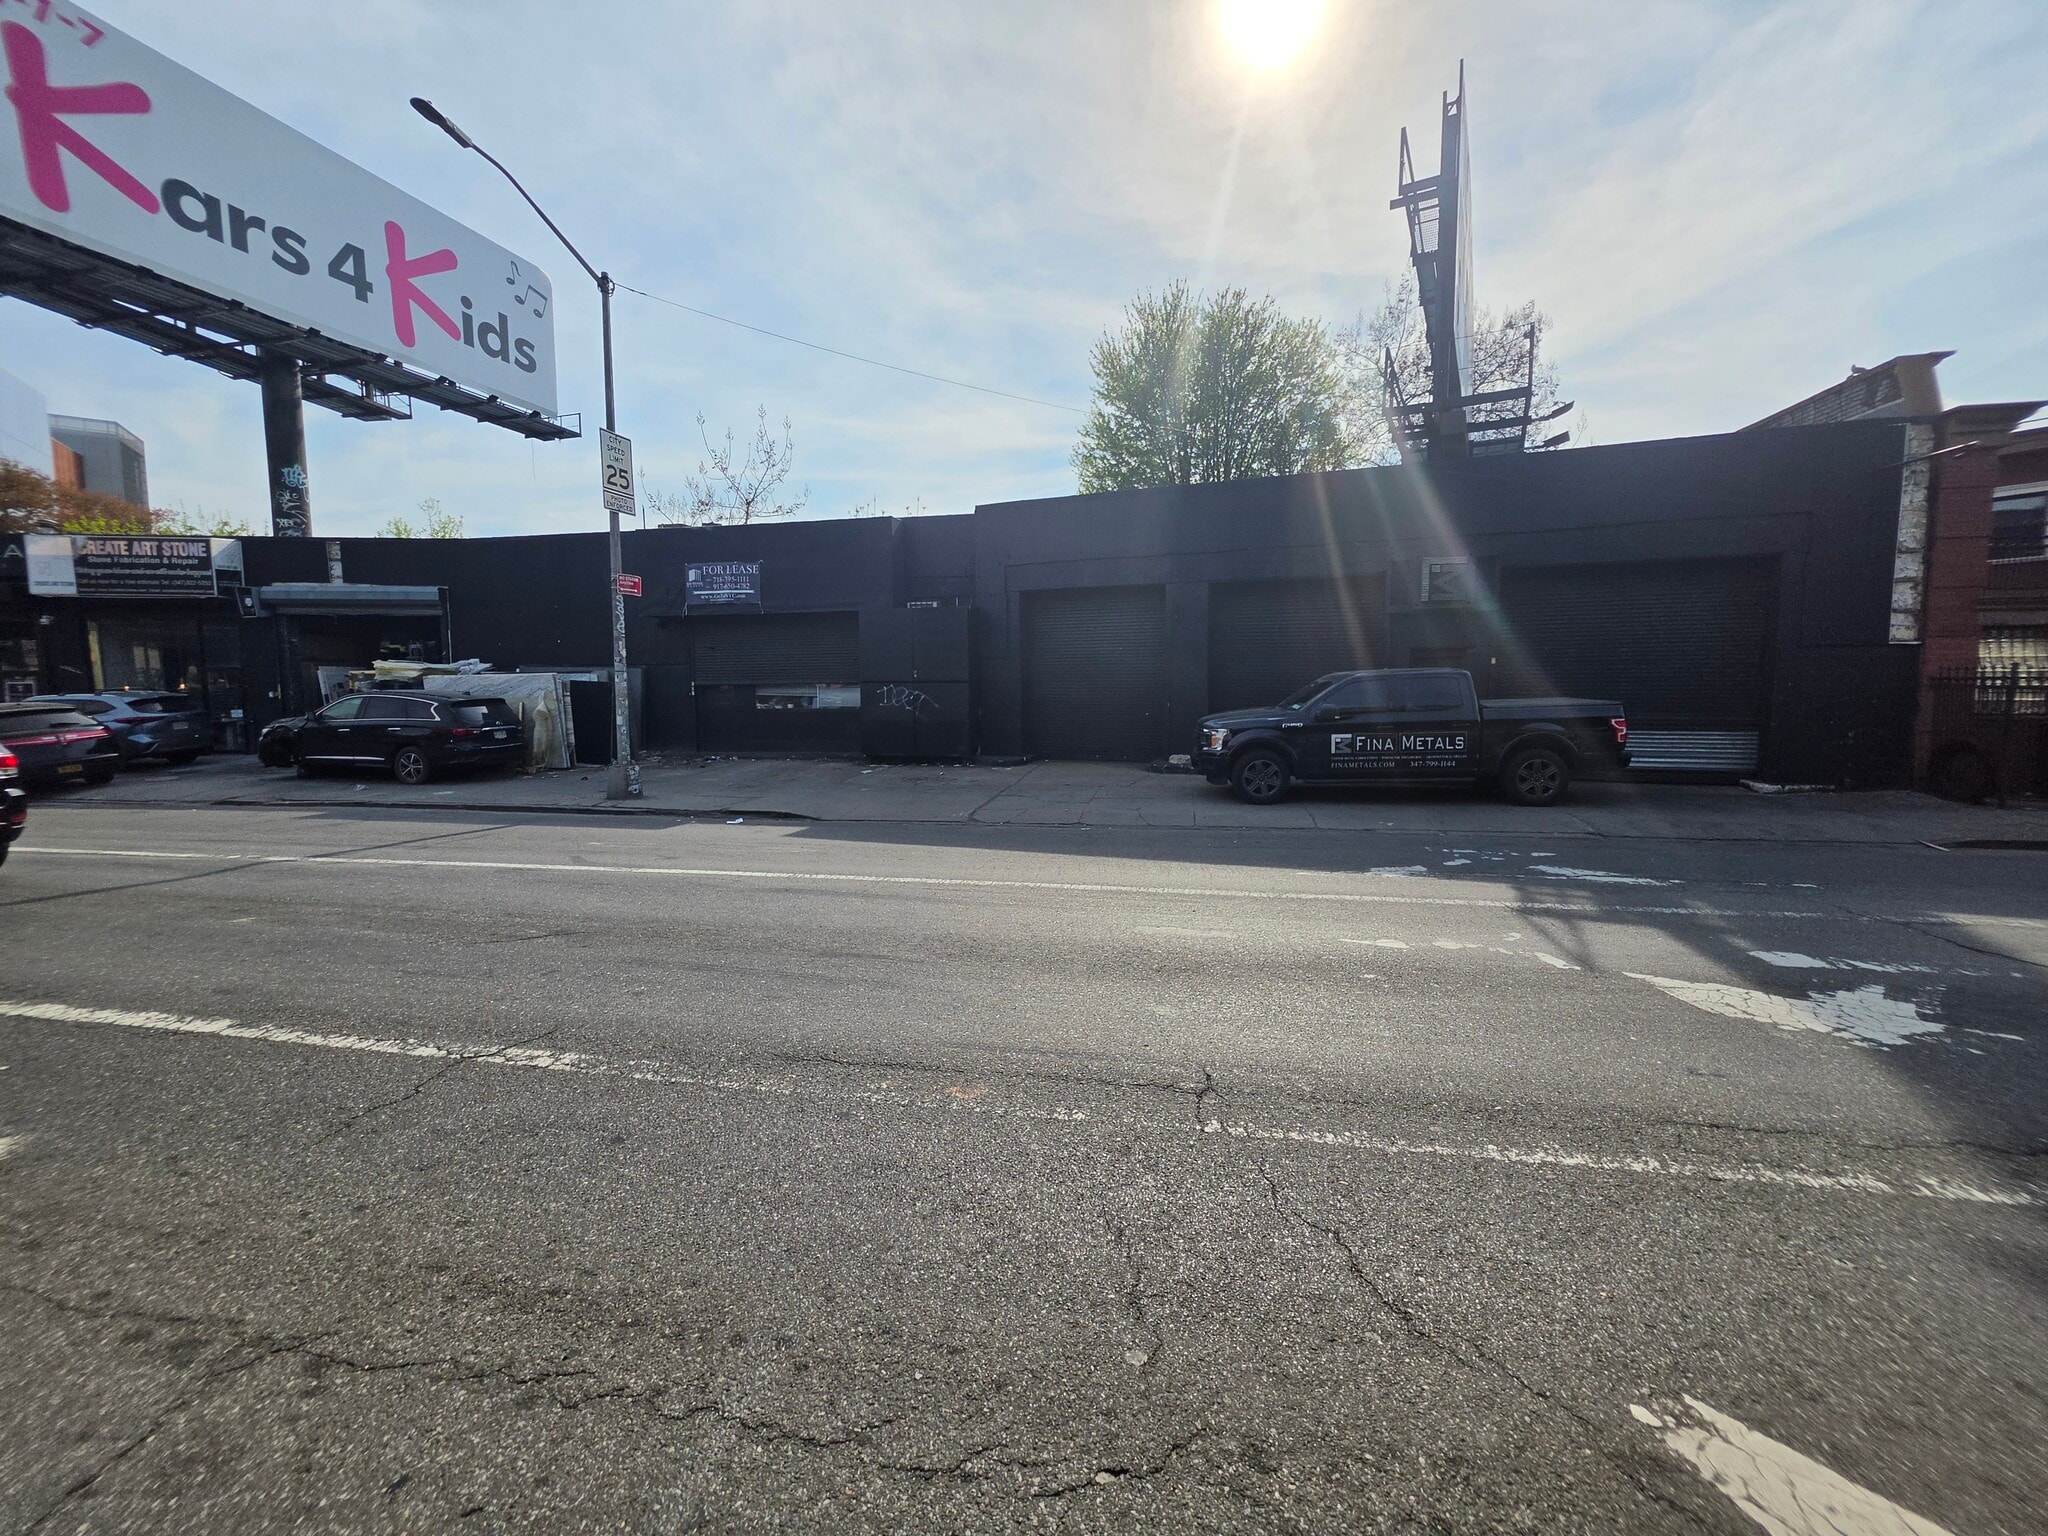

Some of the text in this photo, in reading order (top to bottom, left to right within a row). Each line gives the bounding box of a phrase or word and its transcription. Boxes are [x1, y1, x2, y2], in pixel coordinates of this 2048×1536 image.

[384, 219, 537, 374] Kids
[608, 436, 622, 445] CITY
[606, 444, 625, 456] SPEED
[609, 454, 624, 465] LIMIT
[606, 464, 630, 490] 25
[610, 495, 628, 504] PHOTO
[606, 501, 633, 512] ENFORCED
[132, 541, 159, 556] ART
[162, 541, 207, 557] STONE
[114, 556, 161, 564] Fabrication
[162, 556, 169, 564] &
[171, 557, 199, 565] Repair
[703, 564, 759, 575] FOR LEASE
[1356, 735, 1464, 751] FINA METALS
